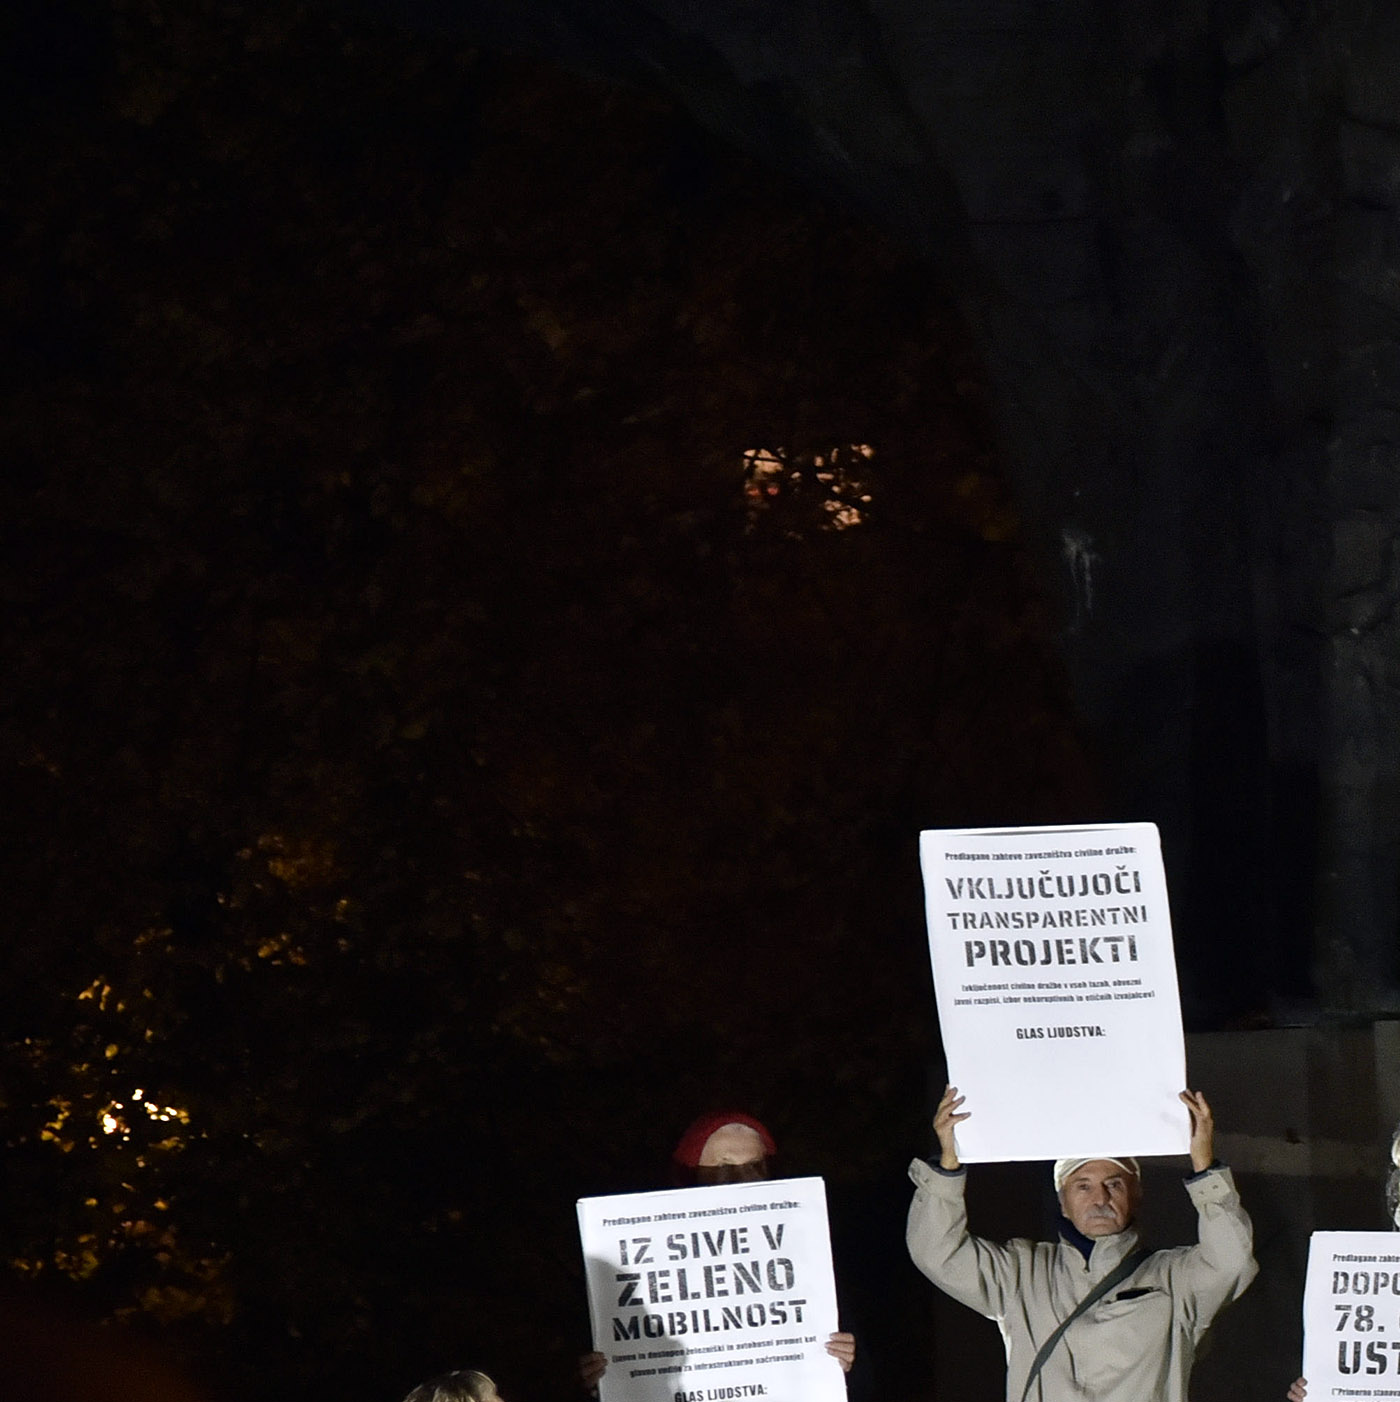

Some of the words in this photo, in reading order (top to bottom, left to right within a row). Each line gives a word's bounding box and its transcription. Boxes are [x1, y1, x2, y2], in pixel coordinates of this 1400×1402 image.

[945, 866, 1141, 899] VKLJUČUJOČI
[946, 906, 1147, 929] TRANSPARENTNI
[964, 936, 1138, 966] PROJEKTI
[1015, 1027, 1045, 1040] GLAS
[1046, 1025, 1106, 1038] LJUDSTVA:
[619, 1237, 655, 1266] IZ
[666, 1227, 750, 1261] SIVE
[761, 1223, 784, 1250] V
[615, 1259, 795, 1307] ZELENO
[613, 1300, 807, 1341] MOBILNOST
[1334, 1304, 1385, 1332] 78.
[707, 1384, 768, 1401] LJUDSTVA:
